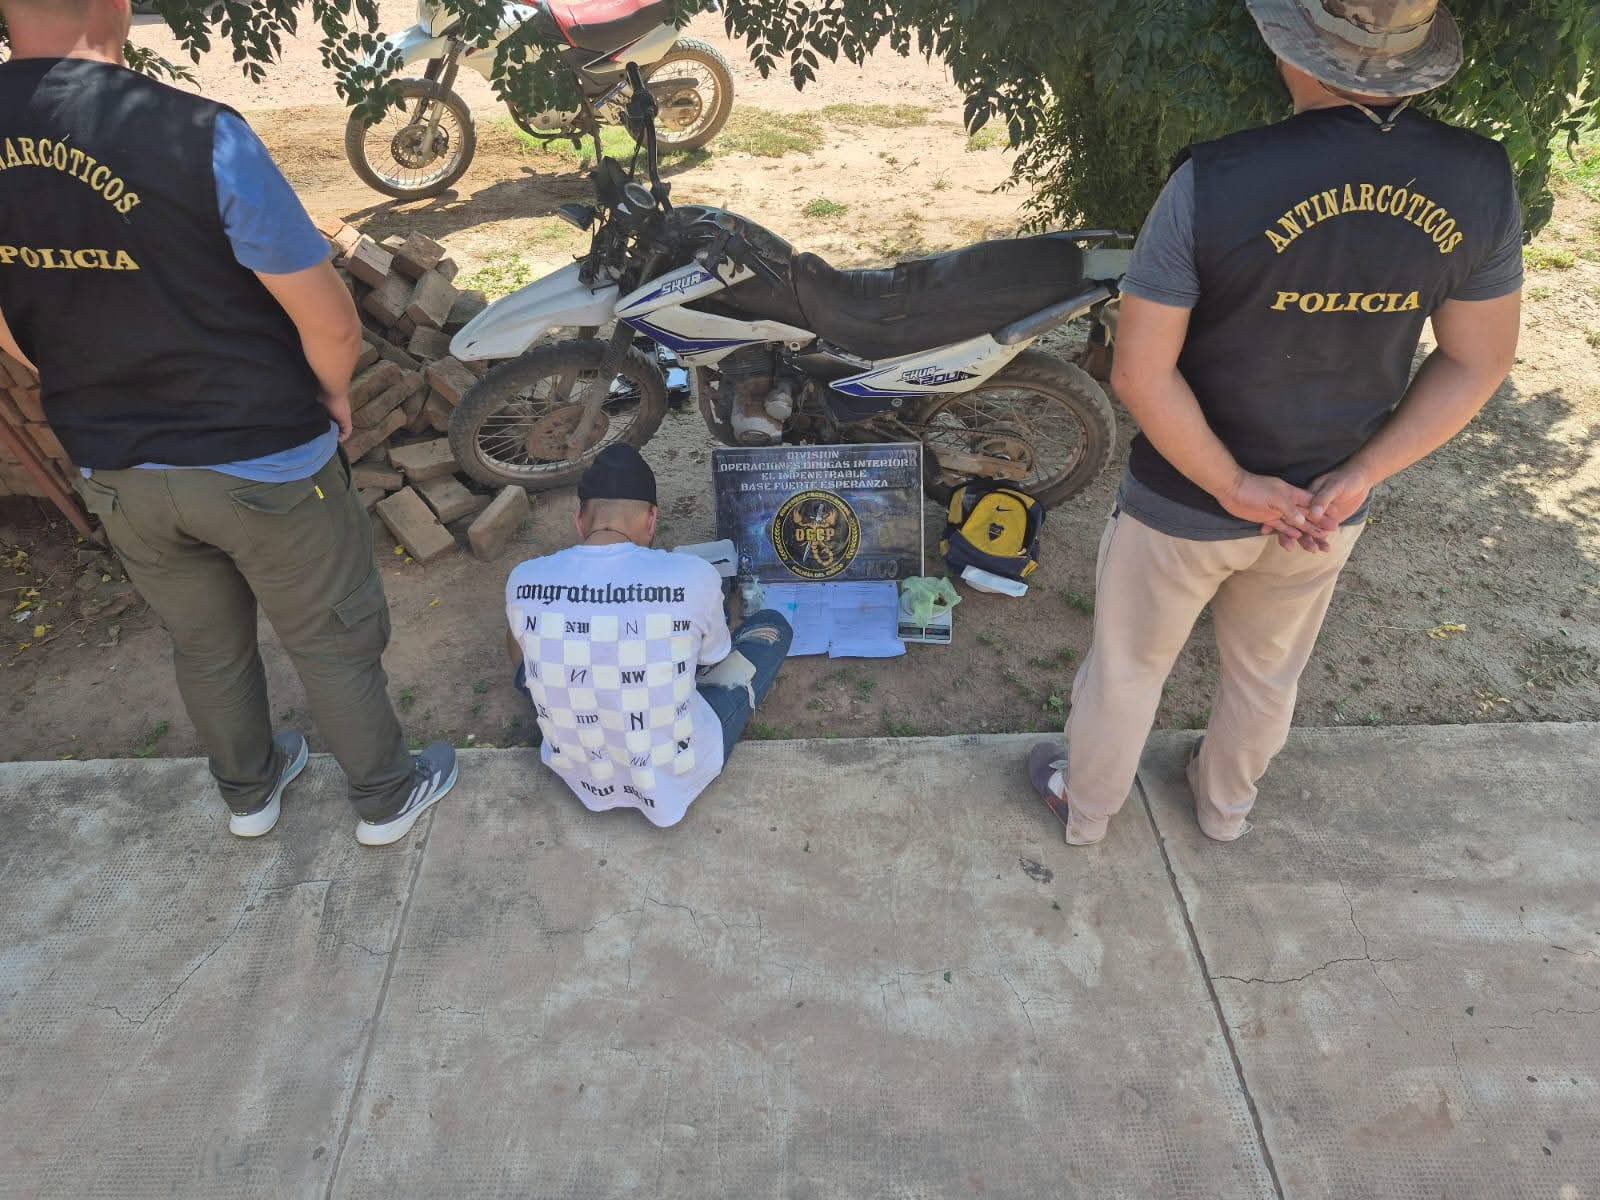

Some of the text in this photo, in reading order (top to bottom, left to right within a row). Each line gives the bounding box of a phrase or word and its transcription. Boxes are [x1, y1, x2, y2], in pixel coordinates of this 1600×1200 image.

[1265, 178, 1463, 254] ANTINARCÓTICOS
[0, 245, 140, 270] POLICIA
[661, 272, 701, 295] SKUA
[1271, 291, 1420, 313] POLICIA
[719, 458, 909, 472] OPERACIONES DROGAS INTERIOR
[778, 469, 867, 480] IMPENETRABLE
[741, 479, 889, 491] BASE FUERTE ESPERANZA
[516, 582, 686, 605] congratulations
[626, 619, 639, 635] N
[621, 670, 646, 684] NW
